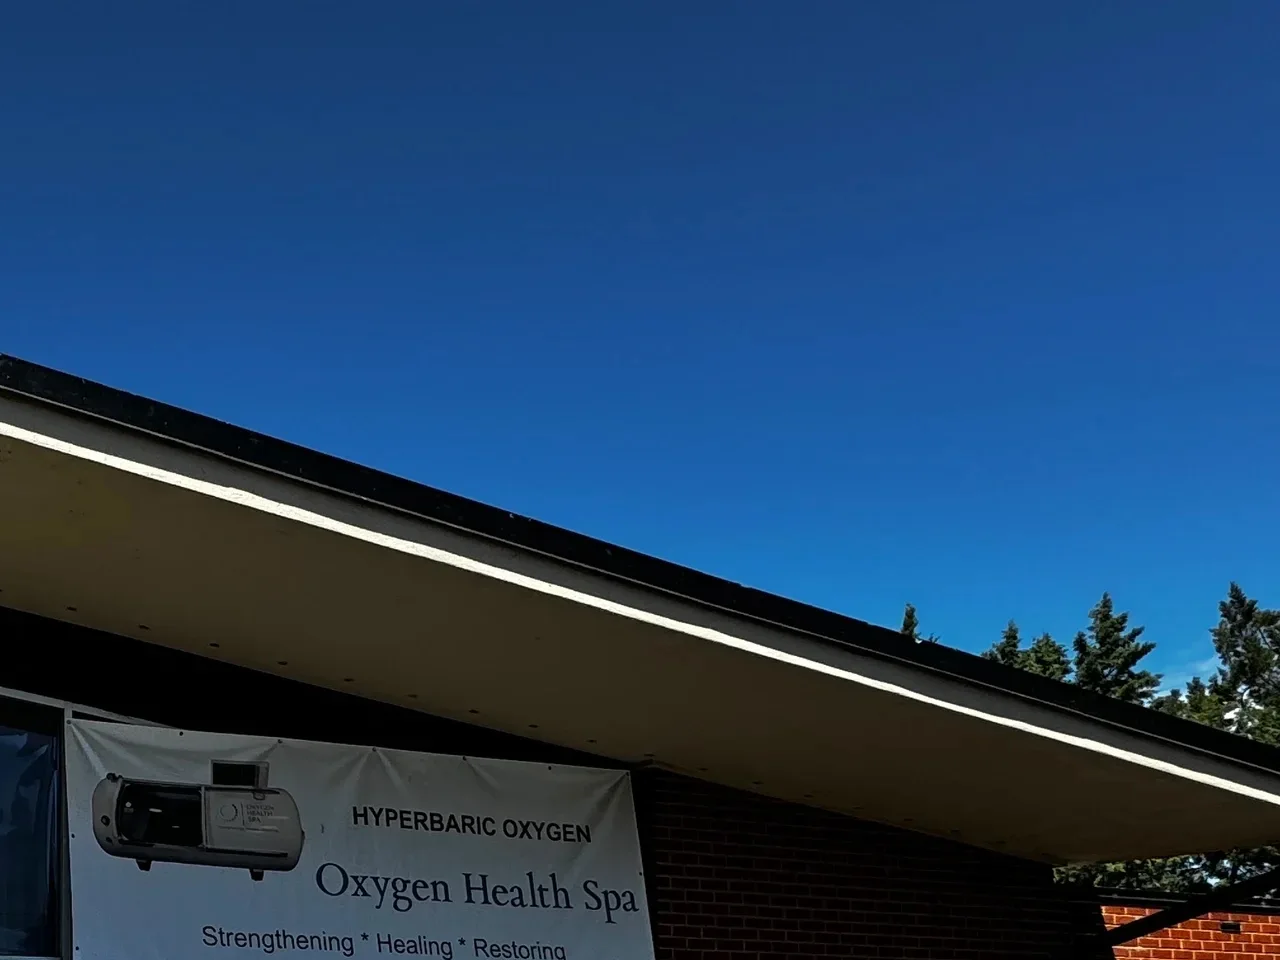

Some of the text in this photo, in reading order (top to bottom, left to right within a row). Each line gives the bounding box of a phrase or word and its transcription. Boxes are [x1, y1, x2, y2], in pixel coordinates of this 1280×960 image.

[352, 806, 591, 843] HYPERBARIC OXYGEN
[315, 862, 640, 924] Oxygen Health Spa
[202, 926, 354, 957] Strengthening
[376, 933, 453, 960] Healing
